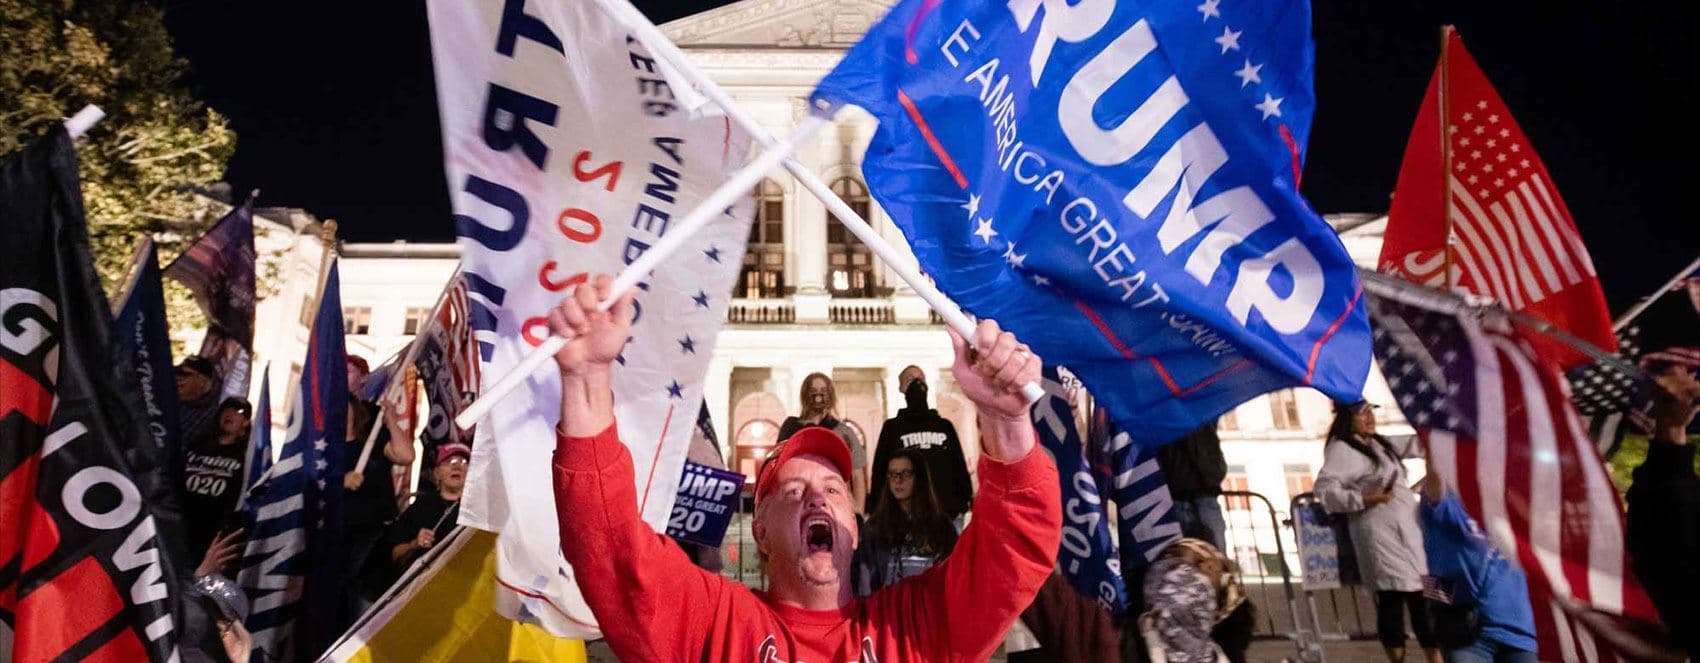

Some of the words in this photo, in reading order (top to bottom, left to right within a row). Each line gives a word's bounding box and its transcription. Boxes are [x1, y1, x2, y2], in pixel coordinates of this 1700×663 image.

[964, 58, 1065, 206] AMERICA
[1060, 197, 1170, 308] GREAT
[900, 431, 947, 449] TRUMP
[694, 499, 728, 515] GREAT
